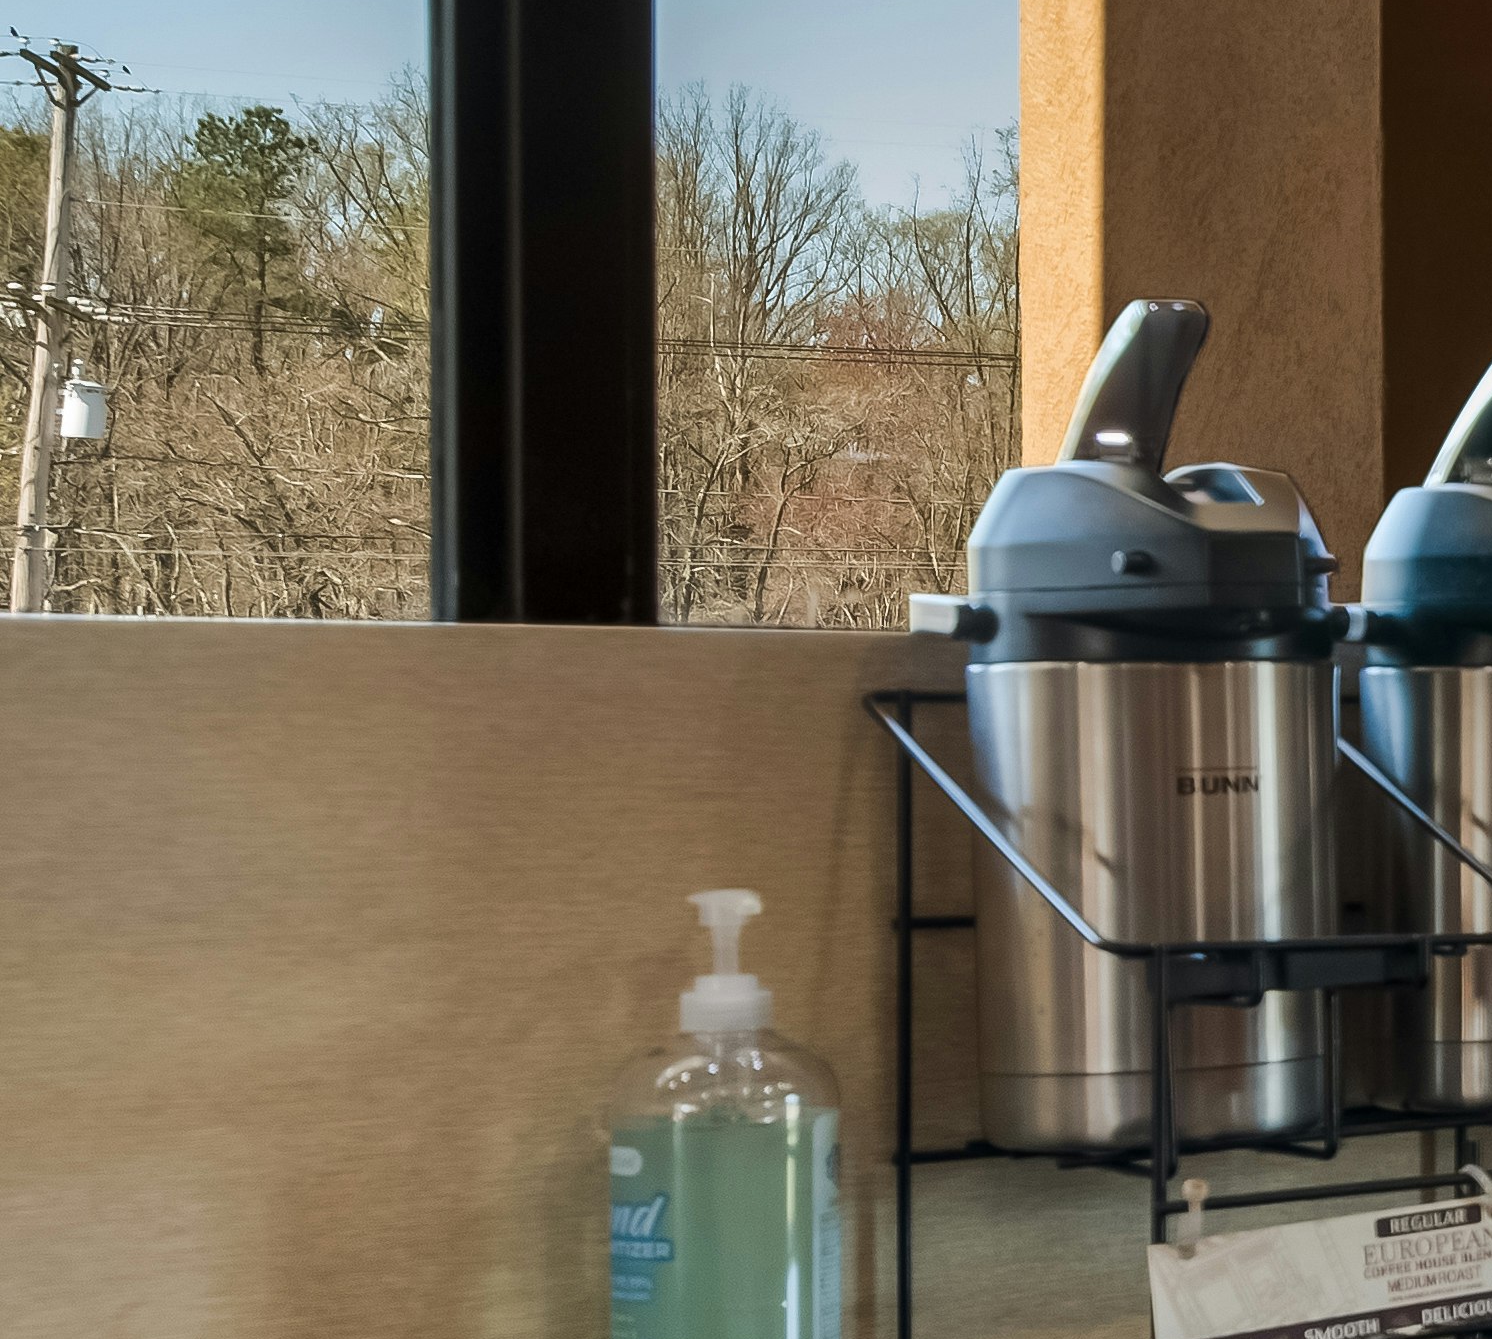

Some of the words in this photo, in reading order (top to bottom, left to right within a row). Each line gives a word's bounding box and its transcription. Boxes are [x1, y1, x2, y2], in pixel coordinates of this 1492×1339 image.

[1177, 775, 1260, 795] BUNN
[1389, 1208, 1467, 1233] REGULAR
[1363, 1261, 1412, 1280] COFFEE
[1415, 1254, 1458, 1273] HOUSE
[1387, 1272, 1438, 1294] MEDIUM
[1438, 1266, 1483, 1286] ROAST
